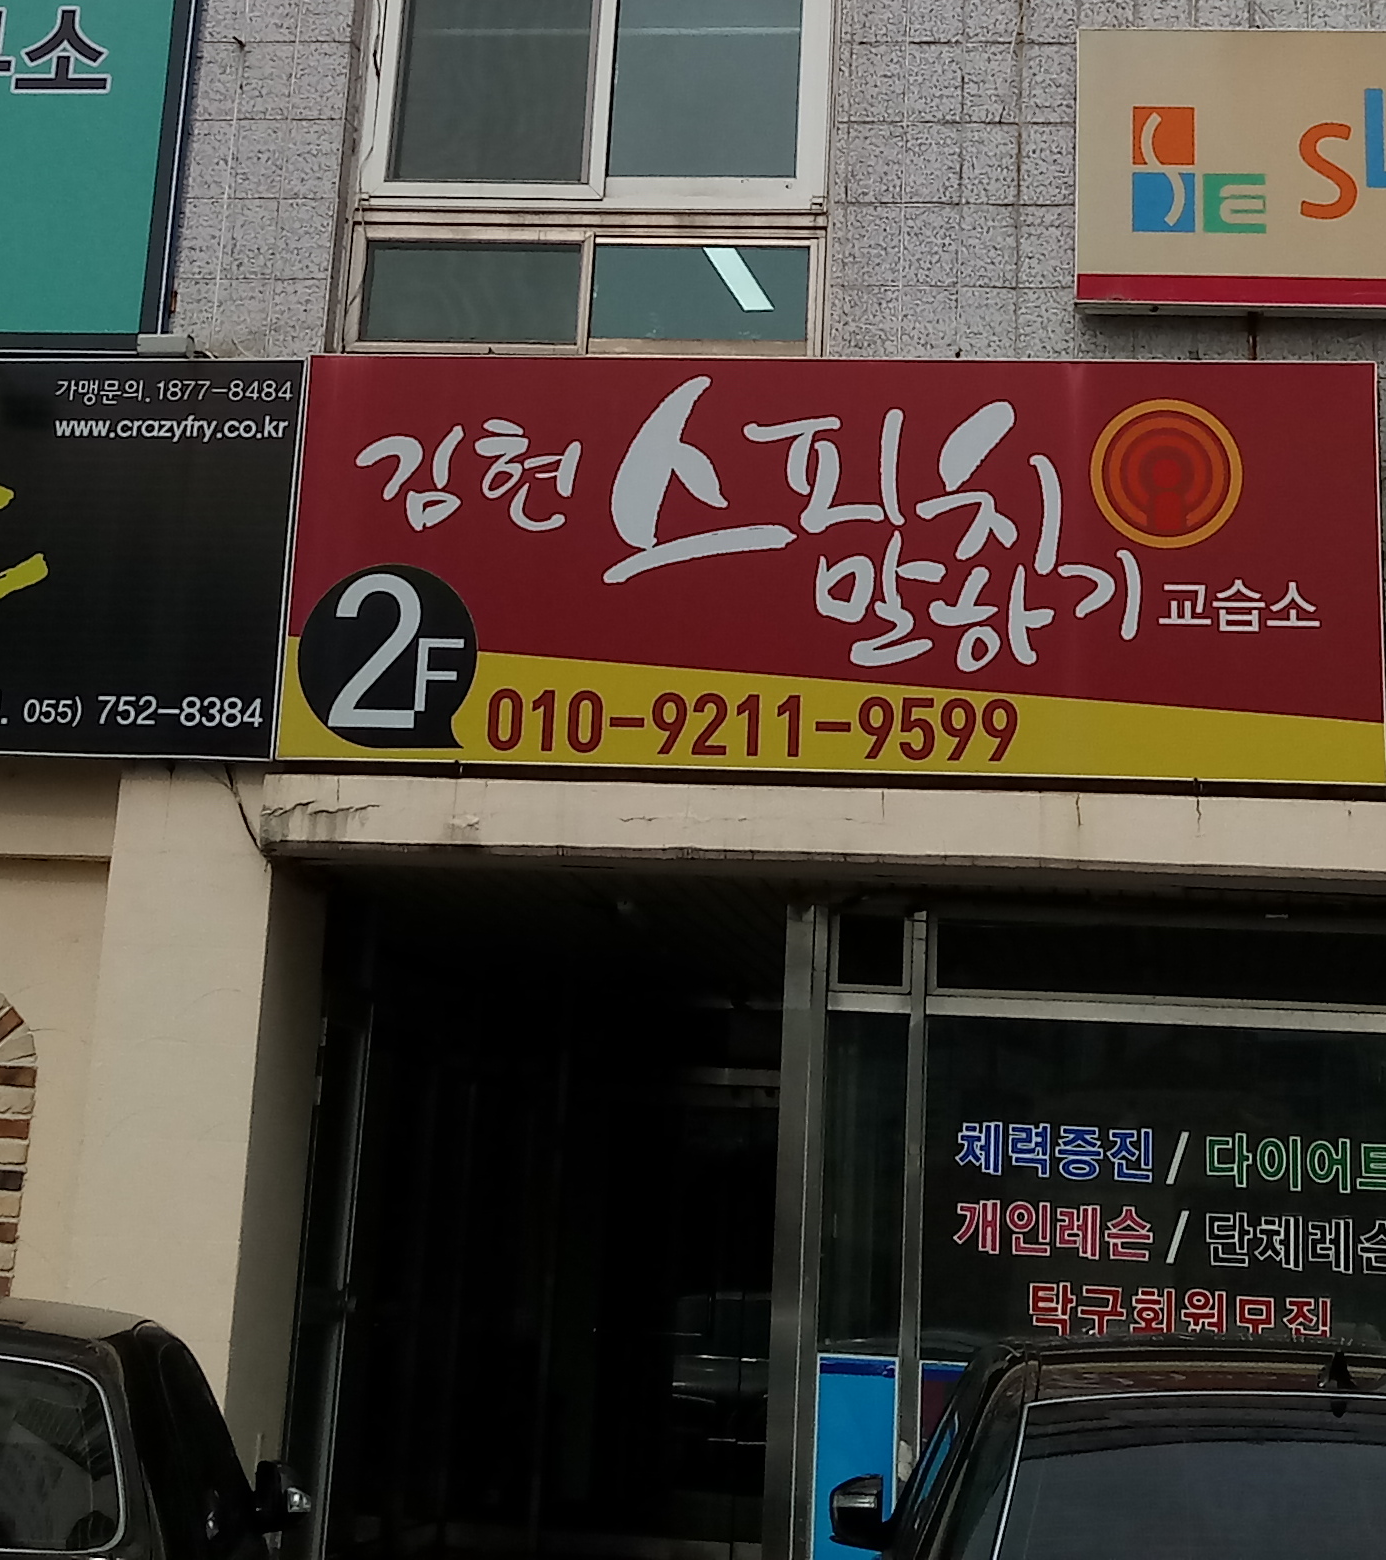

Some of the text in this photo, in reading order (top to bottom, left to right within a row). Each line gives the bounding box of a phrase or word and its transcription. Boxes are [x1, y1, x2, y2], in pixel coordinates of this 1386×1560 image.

[155, 378, 295, 404] 1877-8484
[54, 412, 290, 443] www.crazyfry.co.kr
[354, 416, 582, 533] 김현
[1156, 577, 1323, 634] 교습소
[326, 571, 468, 732] 2F
[22, 694, 84, 730] 055)
[95, 693, 265, 731] 752-8384
[484, 685, 1021, 765] 010-9211-9599
